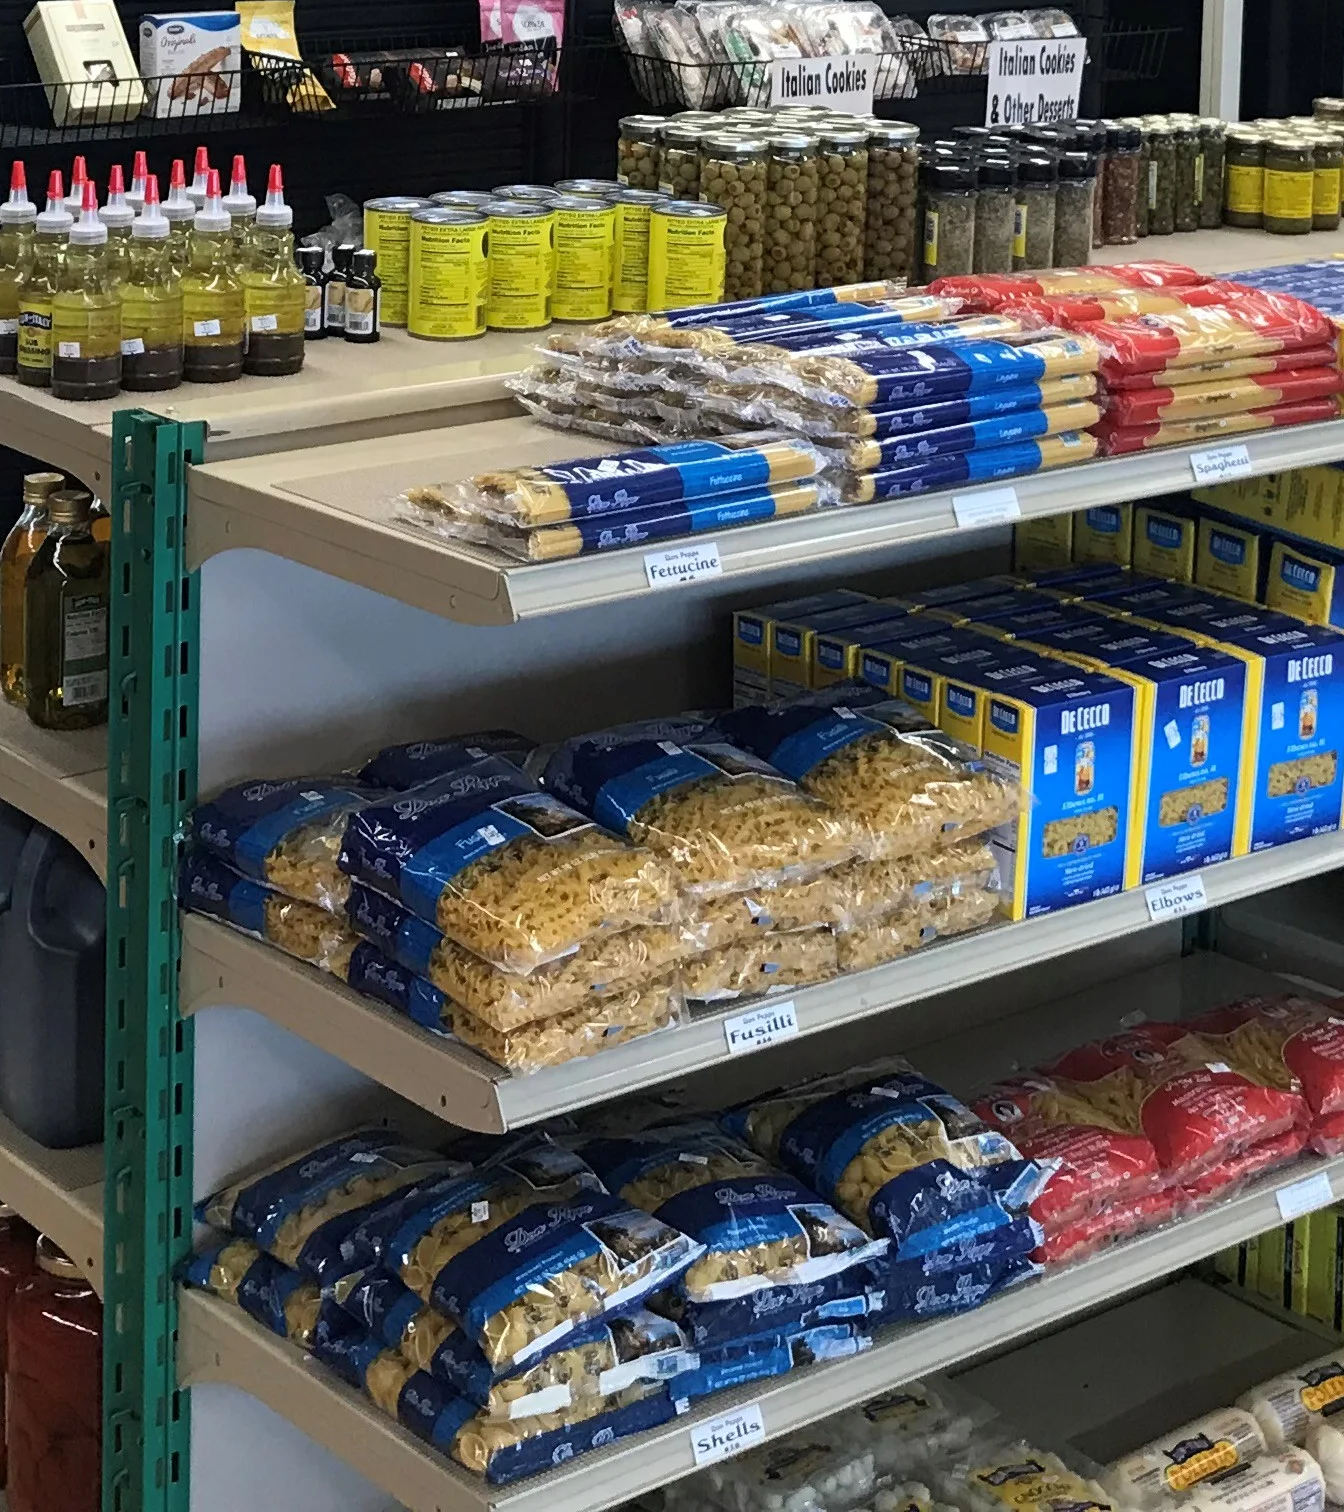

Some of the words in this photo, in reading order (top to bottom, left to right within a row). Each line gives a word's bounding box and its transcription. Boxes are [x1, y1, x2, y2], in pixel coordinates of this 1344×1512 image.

[998, 45, 1036, 77] Italian
[1038, 41, 1076, 75] Cookies
[781, 70, 822, 99] Italian
[825, 65, 868, 96] Cookies
[991, 102, 1000, 125] &
[1004, 98, 1035, 125] Other
[1037, 94, 1074, 120] Desserts
[1196, 455, 1249, 475] Spaghetti
[650, 556, 720, 579] Fettucine
[1288, 659, 1301, 683] DE
[1302, 654, 1333, 680] CECCO
[1180, 684, 1194, 708] DE
[1194, 678, 1225, 706] CECCO
[1061, 709, 1076, 735] DE
[1077, 704, 1110, 731] CECCO
[1151, 888, 1204, 911] Elbows
[727, 1010, 795, 1044] Fusilli
[697, 1421, 762, 1450] Shells
